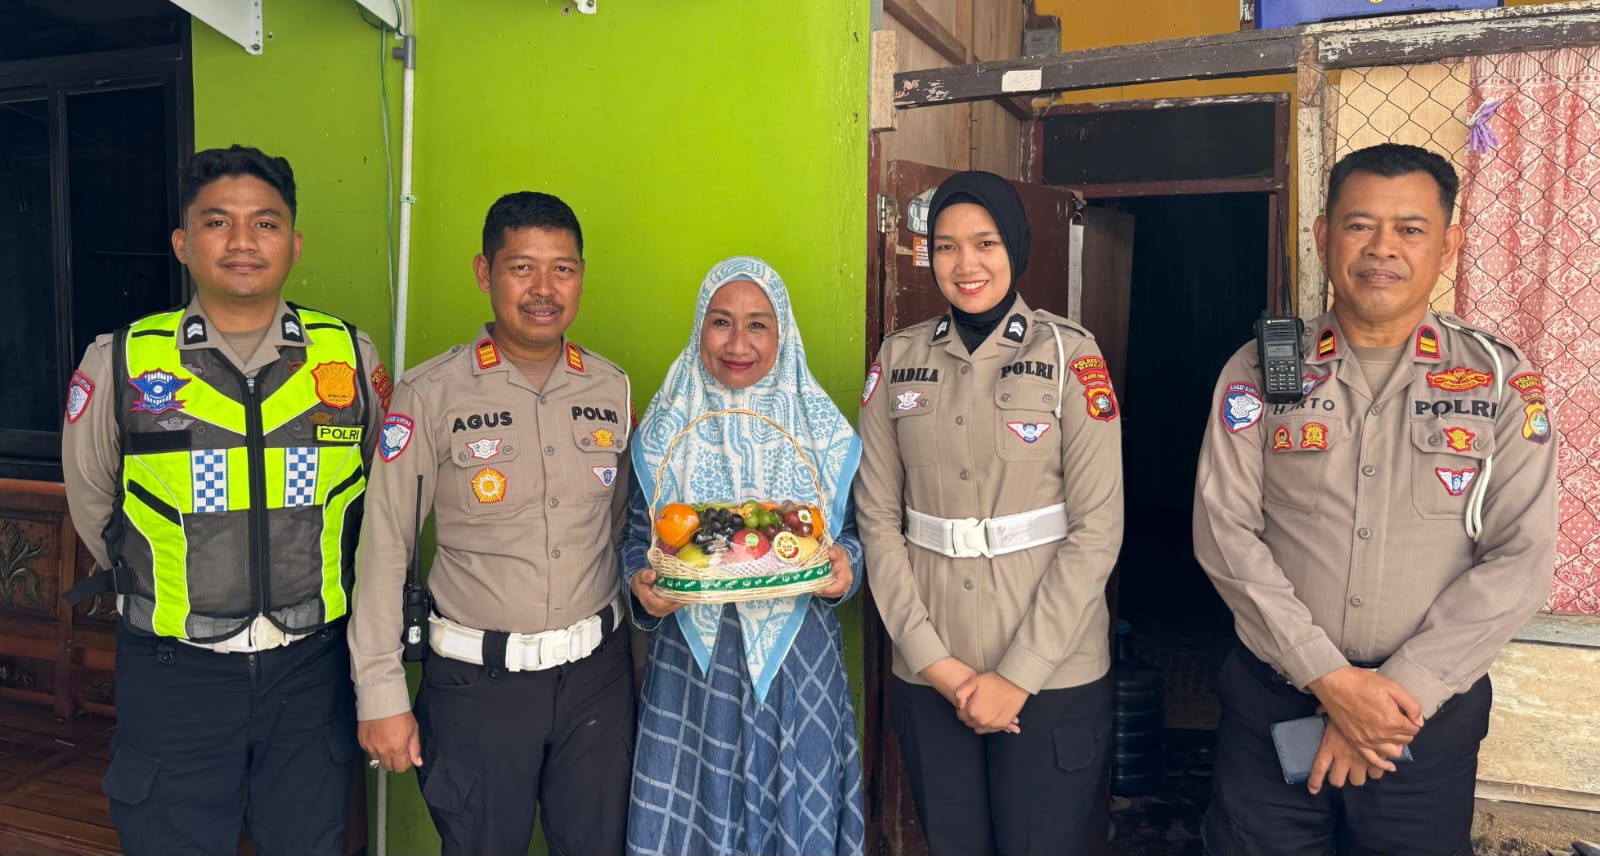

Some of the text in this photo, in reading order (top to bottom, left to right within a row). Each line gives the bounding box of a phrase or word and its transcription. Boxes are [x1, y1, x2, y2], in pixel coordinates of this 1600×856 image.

[890, 367, 939, 384] NADILA
[1000, 361, 1054, 380] POLRI
[571, 406, 618, 424] POLRI
[1415, 400, 1498, 419] POLRI
[452, 411, 513, 433] AGUS
[320, 428, 360, 440] POLRI
